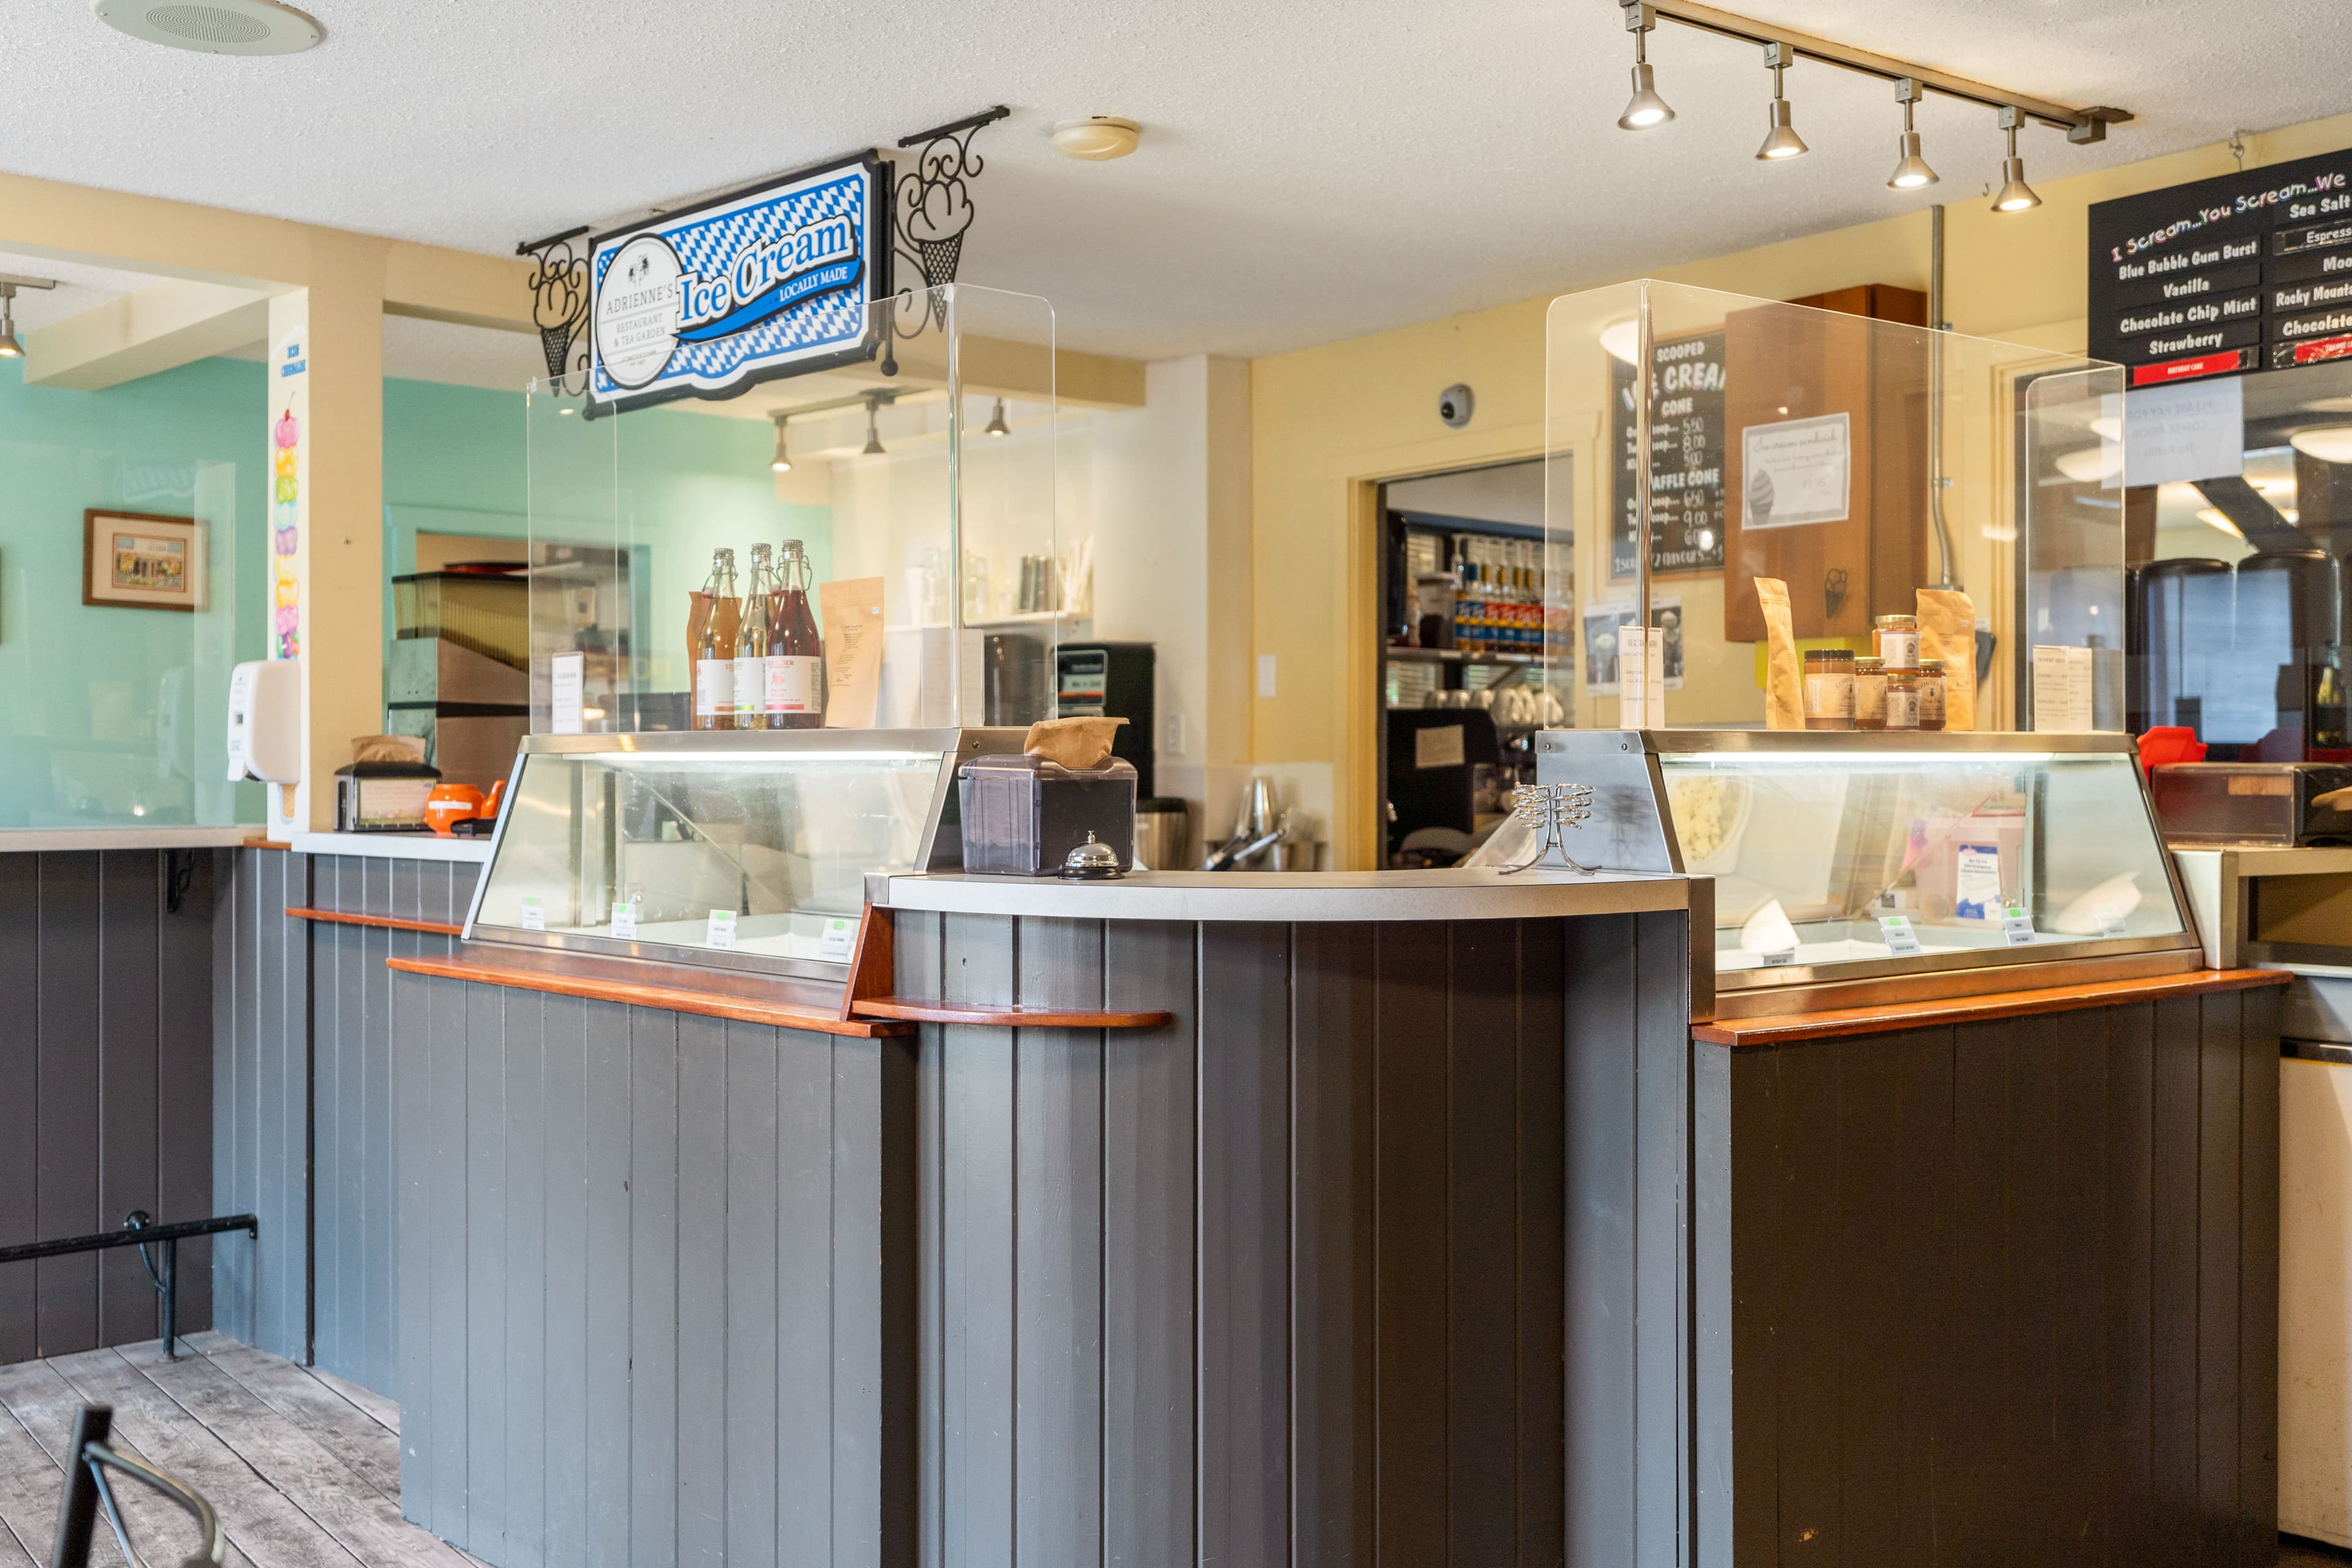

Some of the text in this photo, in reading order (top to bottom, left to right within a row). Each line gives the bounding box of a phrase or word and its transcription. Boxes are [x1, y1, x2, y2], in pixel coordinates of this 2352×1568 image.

[2290, 194, 2351, 218] Sea Salt
[2307, 227, 2352, 244] Espress
[2111, 246, 2123, 262] I
[2119, 239, 2257, 280] Blue Bubble Gum Burst
[680, 221, 848, 322] Ice Cream
[779, 266, 848, 302] LOCALLY MADE
[2163, 277, 2211, 298] Vanilla
[606, 282, 673, 315] ADRIENNE'S
[2276, 288, 2311, 306] Rocky
[616, 313, 663, 334] RESTAURANT
[2120, 297, 2256, 333] Chocolate Chip Mint
[621, 334, 635, 346] TEA
[636, 326, 666, 339] GARDEN
[2149, 332, 2224, 355] Strawberry
[1656, 340, 1705, 363] SCOOPED
[1660, 397, 1694, 418] CONE
[1687, 467, 1720, 486] CONE
